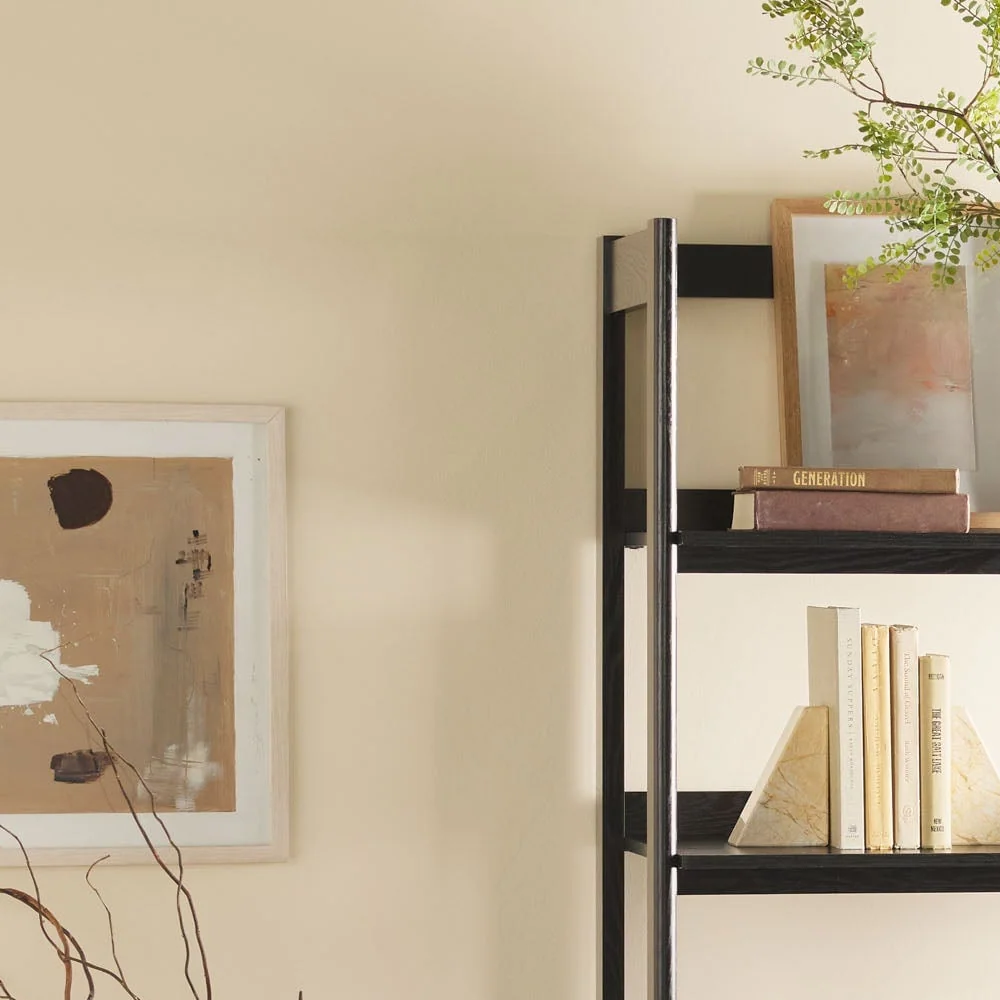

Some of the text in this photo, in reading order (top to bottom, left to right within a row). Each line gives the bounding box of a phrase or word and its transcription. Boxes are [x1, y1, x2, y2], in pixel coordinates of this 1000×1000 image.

[793, 470, 866, 487] GENERATION
[931, 708, 942, 773] THE GREAT SALT LAKE
